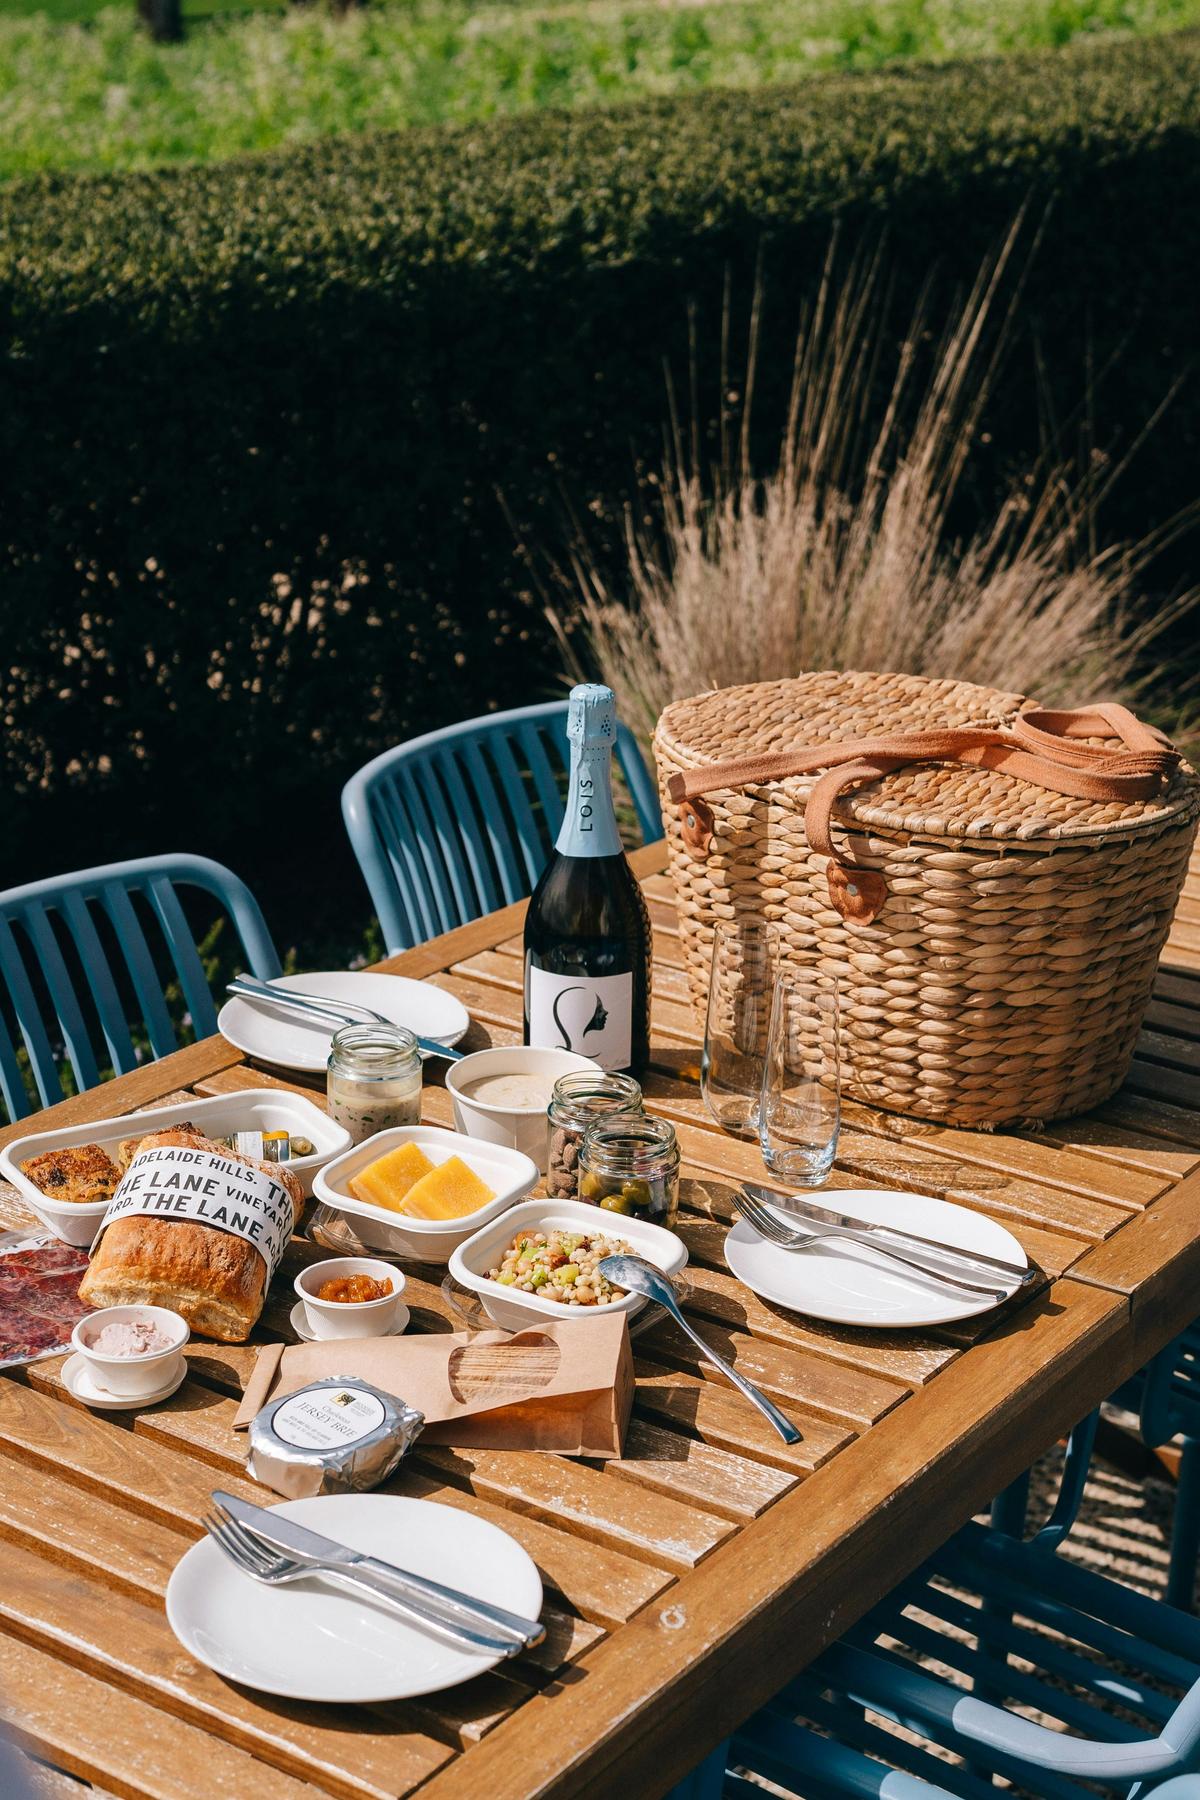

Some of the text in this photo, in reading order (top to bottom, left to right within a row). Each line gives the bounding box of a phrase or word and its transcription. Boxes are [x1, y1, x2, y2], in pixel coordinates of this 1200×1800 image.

[580, 779, 593, 832] LOIS
[117, 1173, 146, 1199] HE
[150, 1171, 220, 1197] LANE
[132, 1150, 205, 1169] ADELAIDE
[208, 1157, 258, 1185] HILLS.
[142, 1192, 192, 1212] THE
[196, 1199, 264, 1242] LANE
[295, 1402, 334, 1425] JERSEY
[331, 1418, 358, 1437] BRIE
